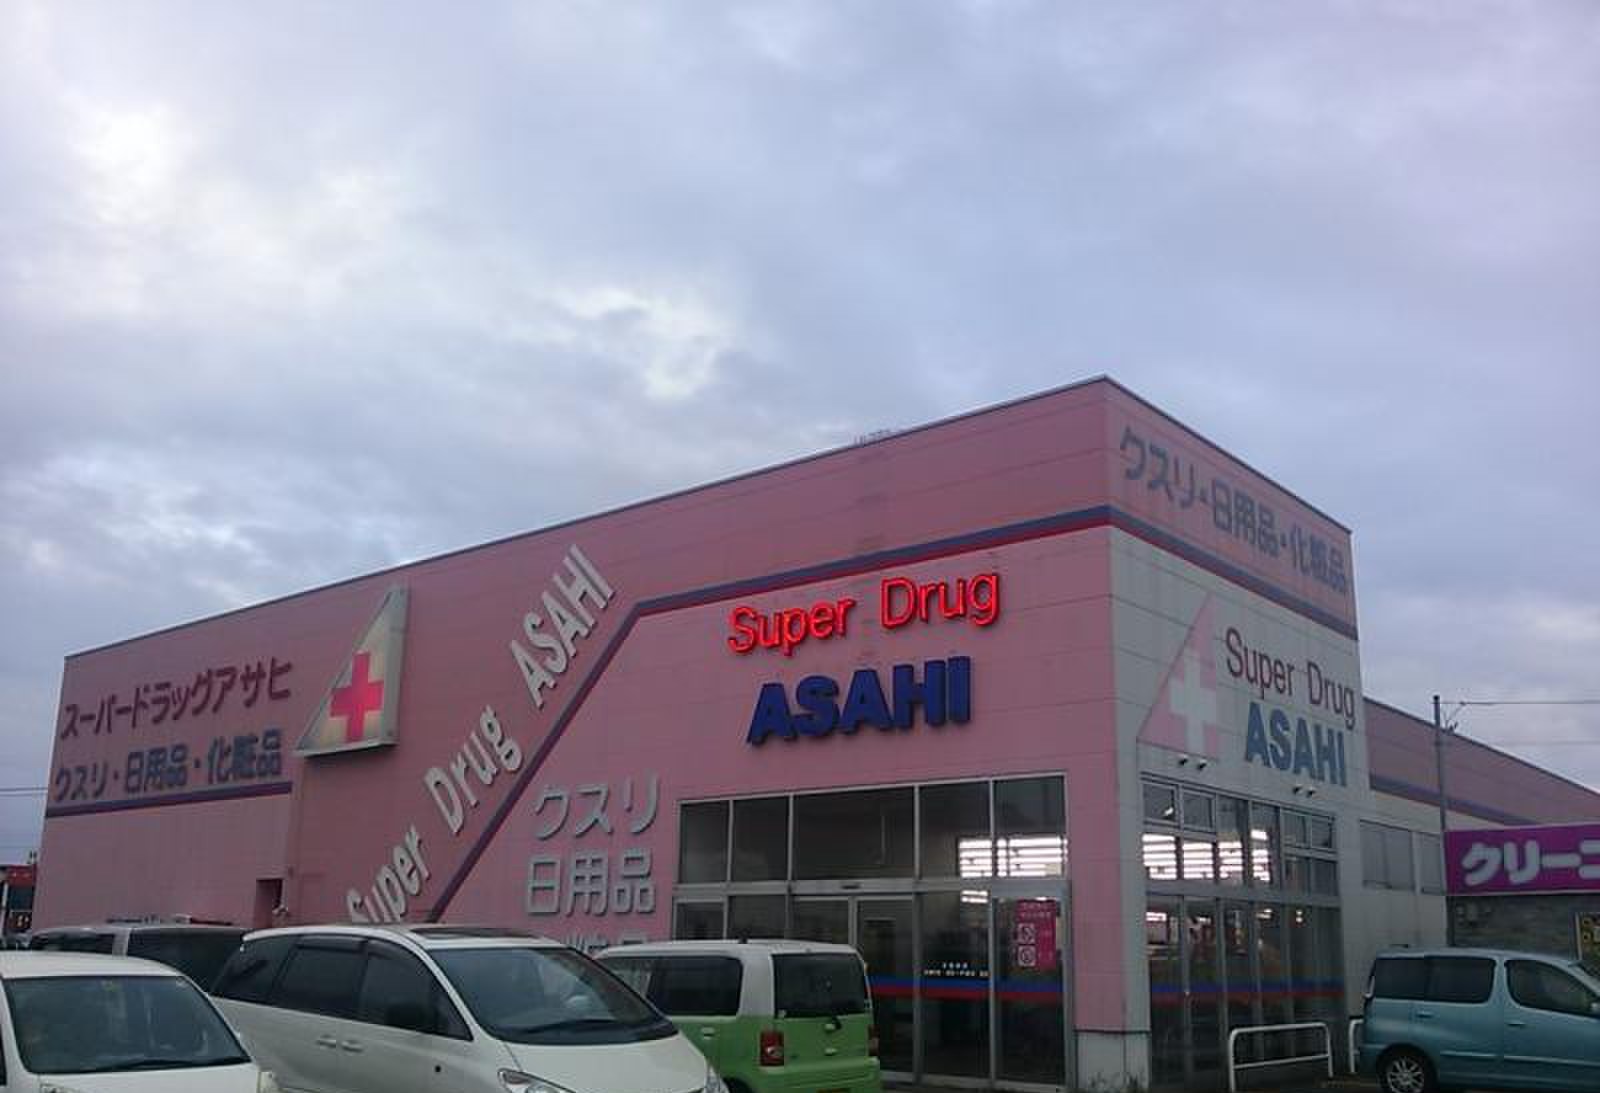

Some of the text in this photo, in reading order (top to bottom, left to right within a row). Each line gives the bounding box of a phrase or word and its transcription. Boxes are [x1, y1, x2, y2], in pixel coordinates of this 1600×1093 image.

[728, 572, 999, 656] Super Drug
[61, 656, 293, 740] スーパードラッグアサヒ
[424, 704, 524, 835] Drug
[510, 543, 616, 708] ASAHI
[747, 655, 972, 746] ASAHI
[1226, 628, 1357, 731] Super Drug
[1245, 702, 1349, 787] ASAHI
[533, 772, 660, 840] クスリ
[526, 846, 657, 917] 日用品
